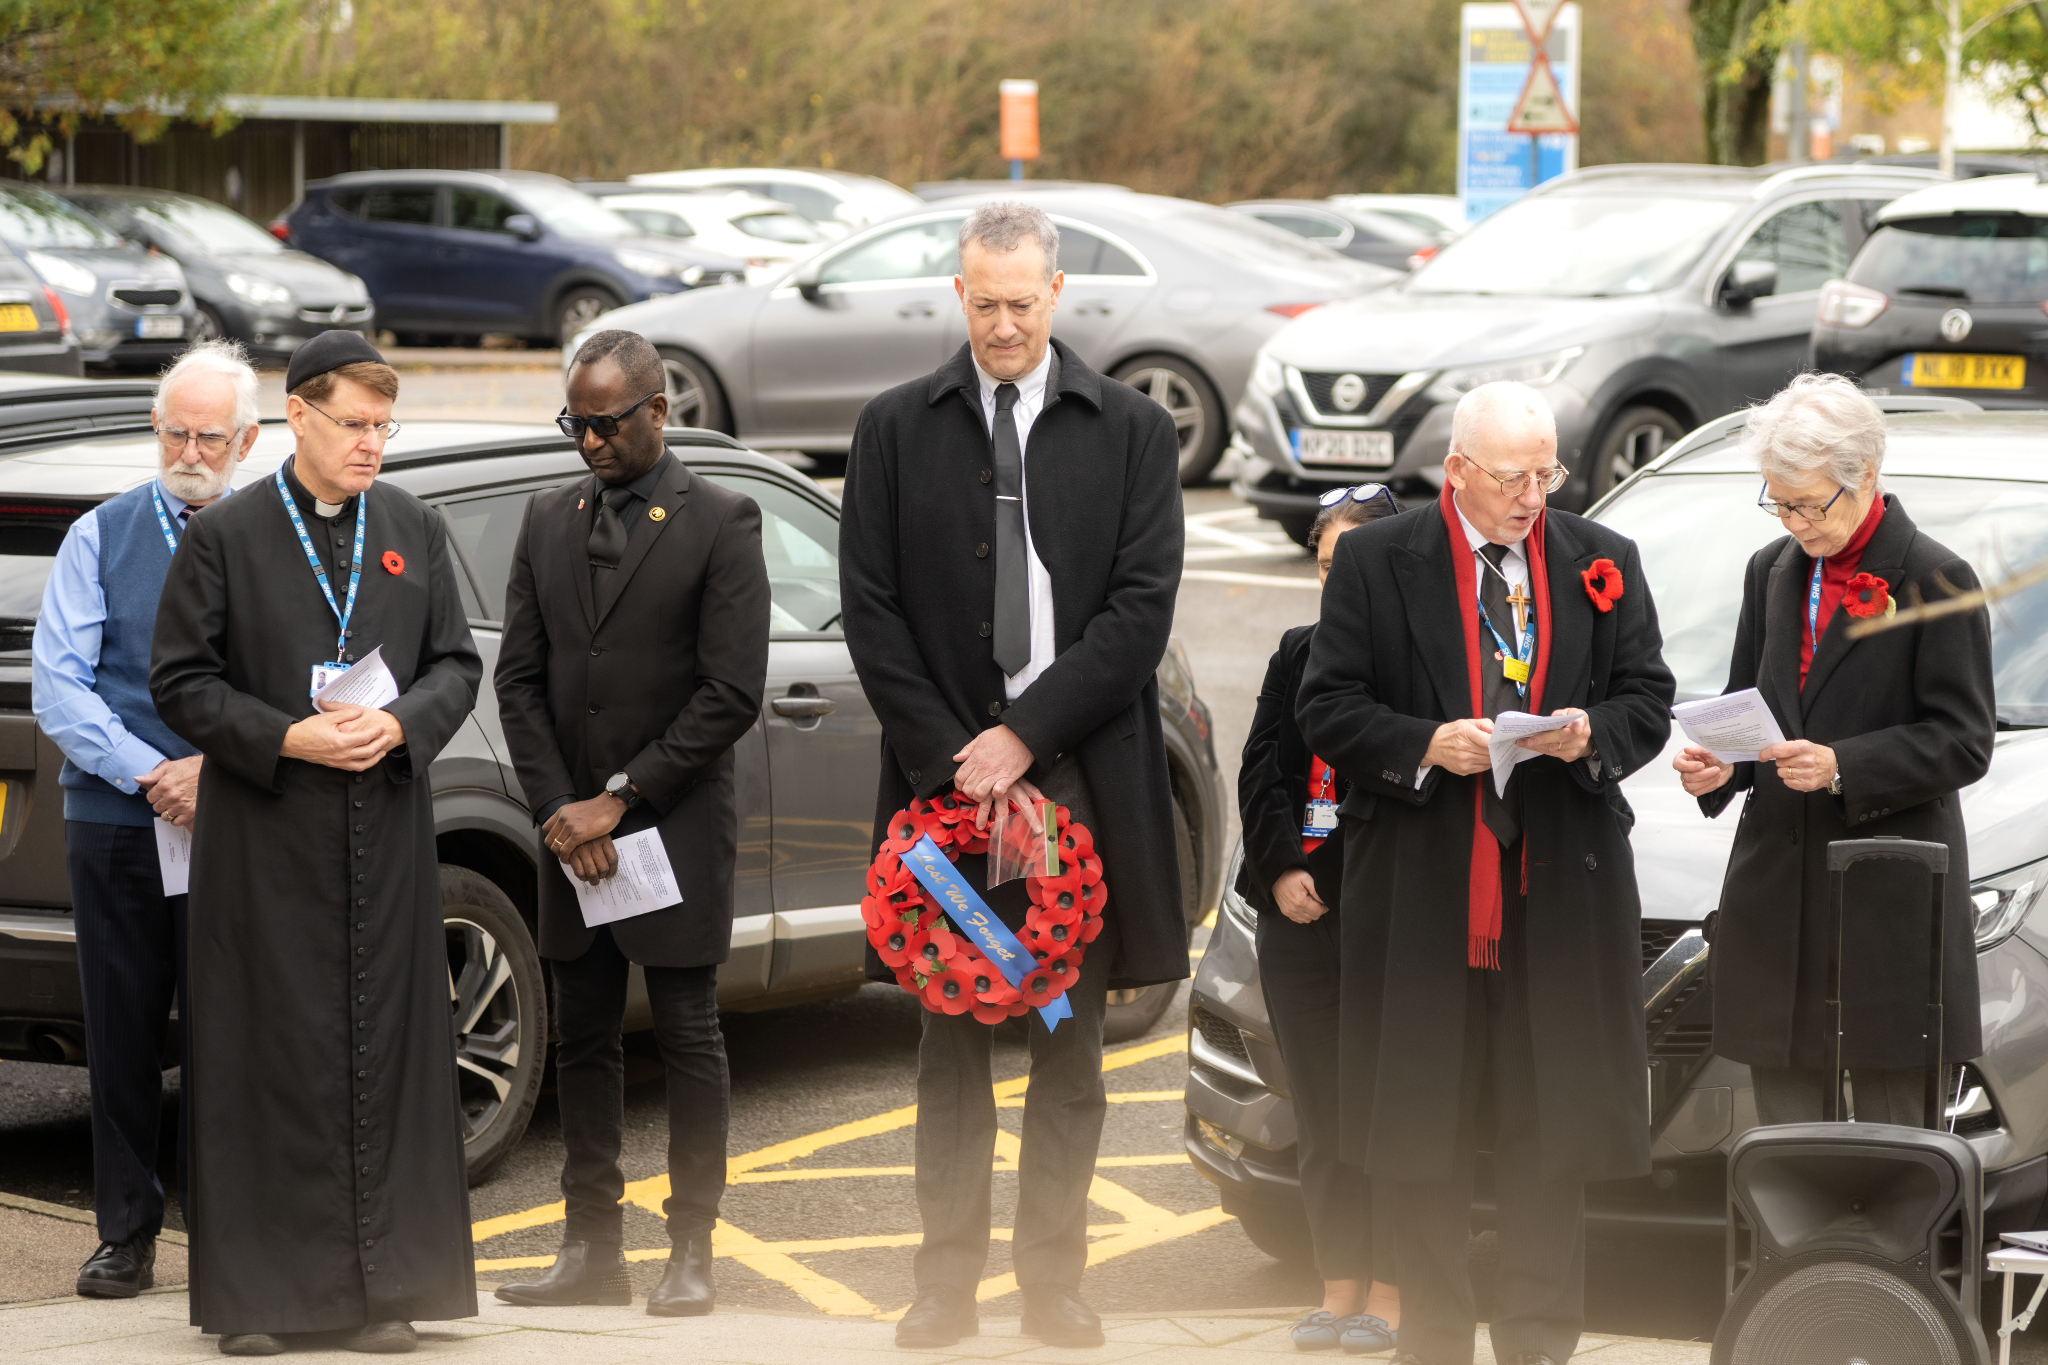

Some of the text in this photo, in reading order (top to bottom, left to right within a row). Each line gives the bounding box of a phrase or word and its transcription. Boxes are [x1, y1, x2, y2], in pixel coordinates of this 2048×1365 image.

[280, 486, 291, 501] NHS
[155, 499, 163, 513] NHS
[287, 504, 300, 518] NHS
[160, 516, 170, 530] NHS
[295, 522, 307, 537] NHS
[356, 523, 364, 539] NHS
[166, 533, 177, 548] NHS
[303, 541, 315, 556] NHS
[354, 541, 363, 558] NHS
[321, 582, 333, 598] NHS
[349, 581, 357, 598] NHS
[1812, 583, 1820, 599] NHS
[1523, 632, 1533, 649] NHS
[912, 853, 1016, 961] Lest We Forget
